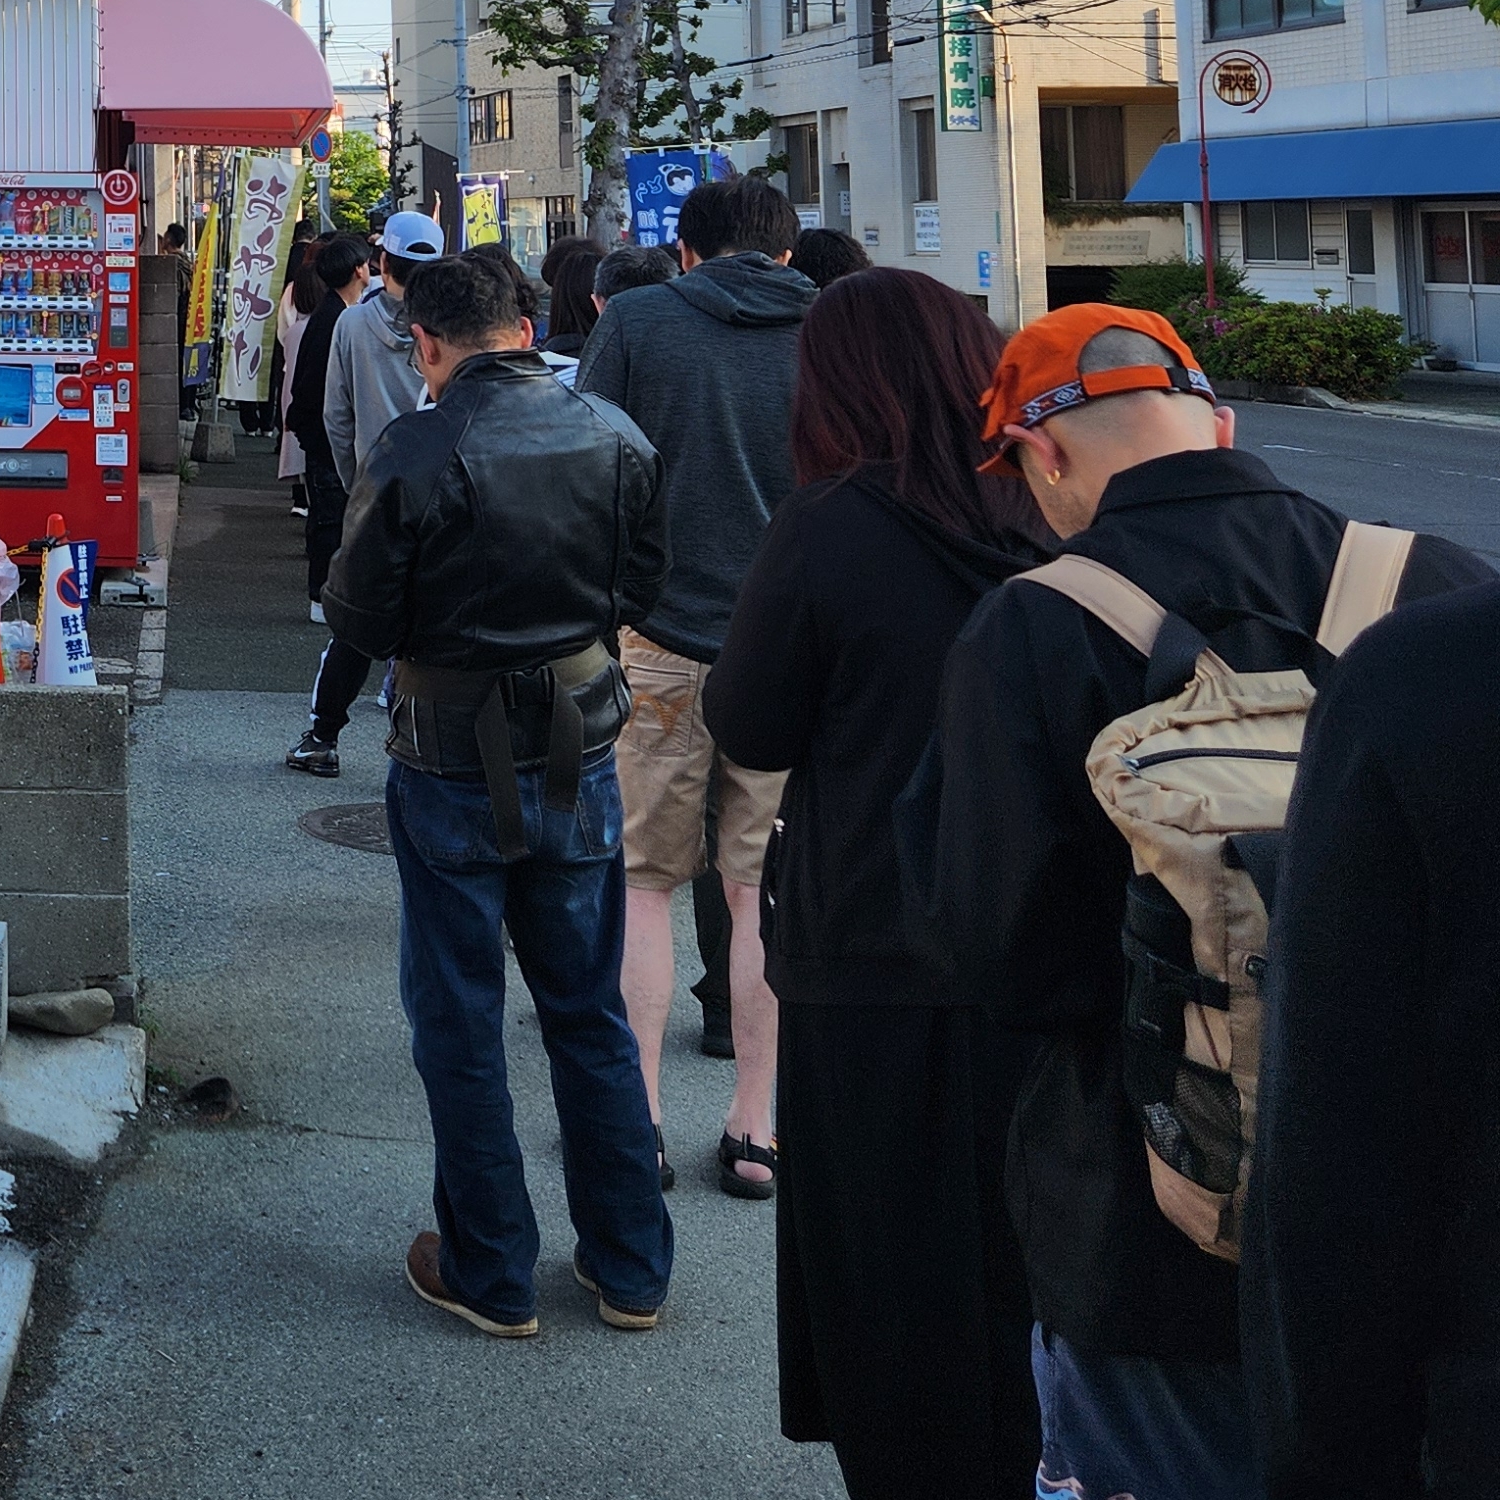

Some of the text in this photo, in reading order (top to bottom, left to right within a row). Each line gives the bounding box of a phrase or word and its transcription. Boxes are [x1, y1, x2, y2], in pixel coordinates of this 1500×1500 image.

[1217, 73, 1258, 92] 消火栓
[77, 544, 89, 599] 駐車禁止
